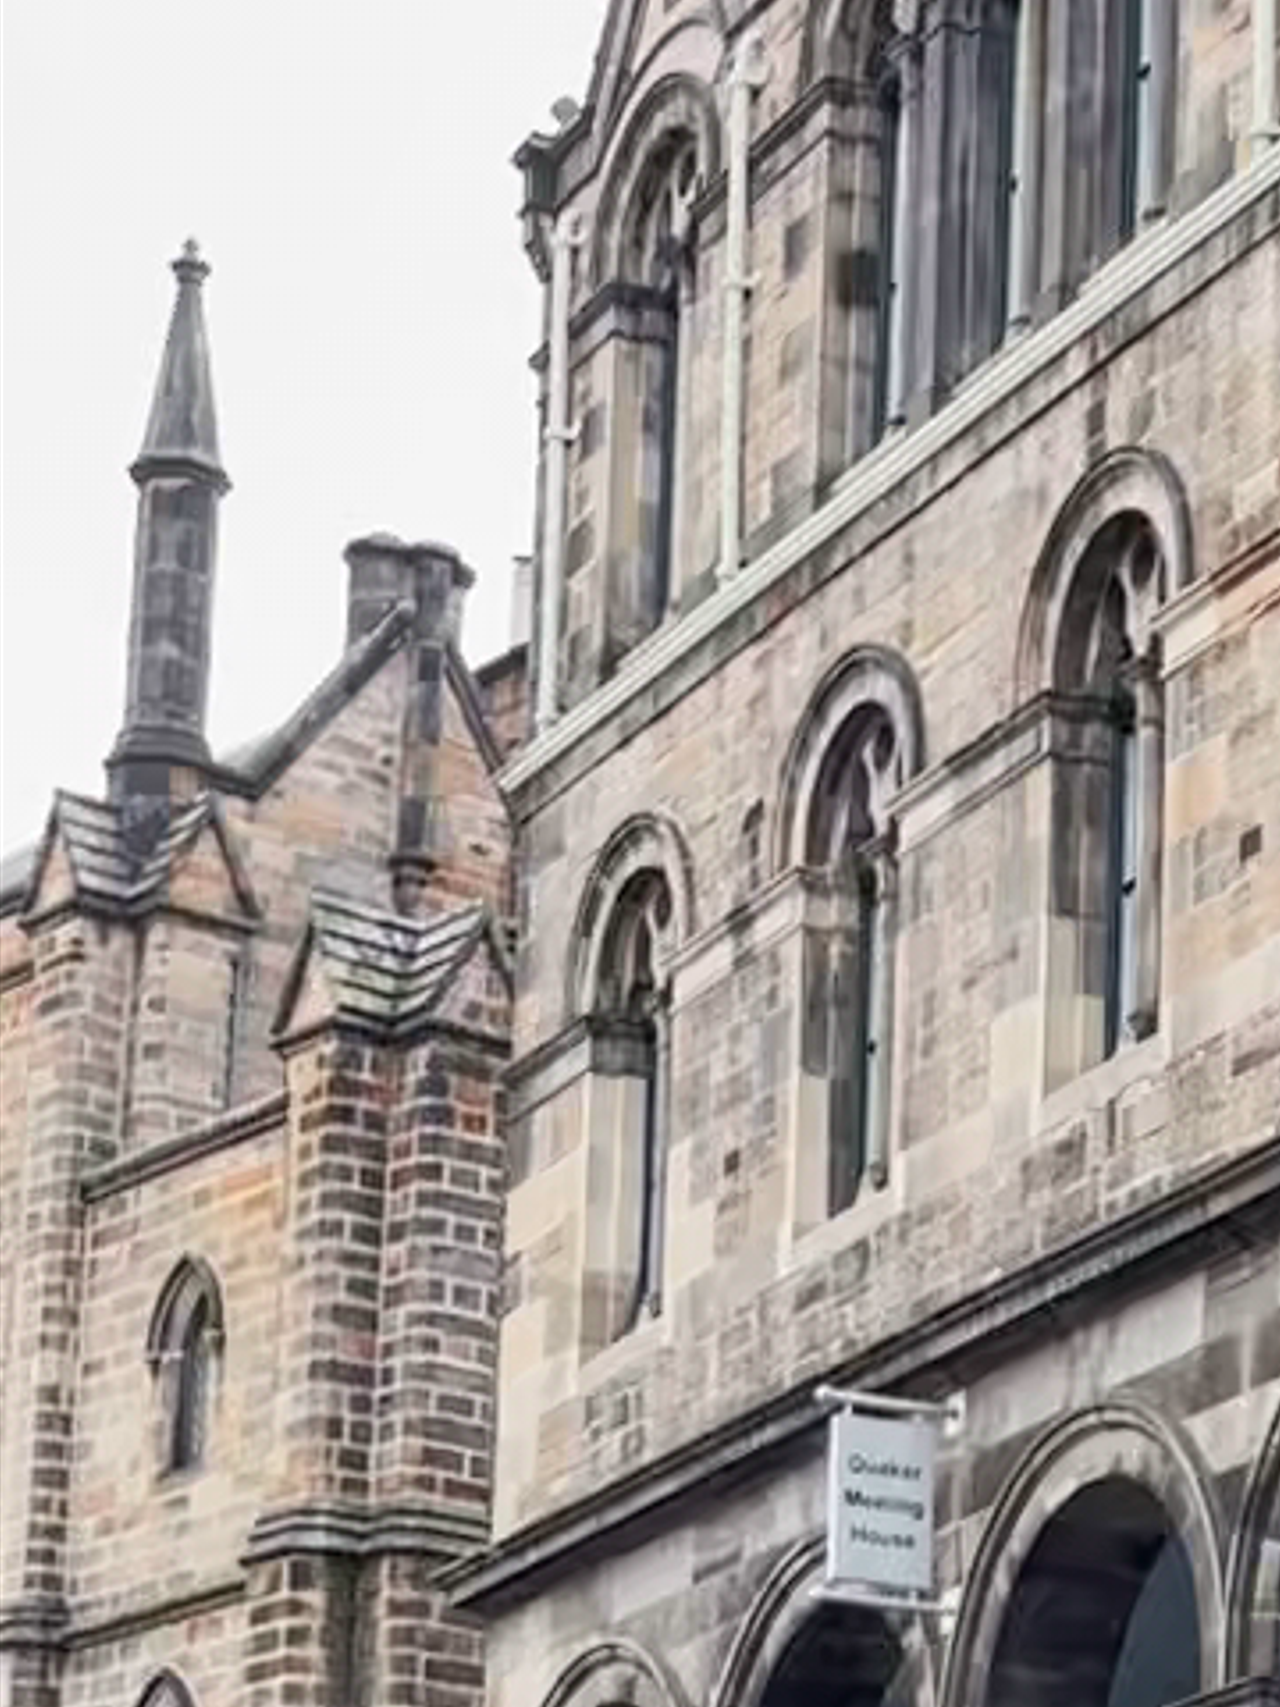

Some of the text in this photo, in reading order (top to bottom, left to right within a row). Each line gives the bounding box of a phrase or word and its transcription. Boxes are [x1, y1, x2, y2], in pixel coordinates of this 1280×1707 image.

[848, 1453, 921, 1481] Quaker
[844, 1488, 925, 1521] Meeting
[850, 1524, 916, 1550] House
